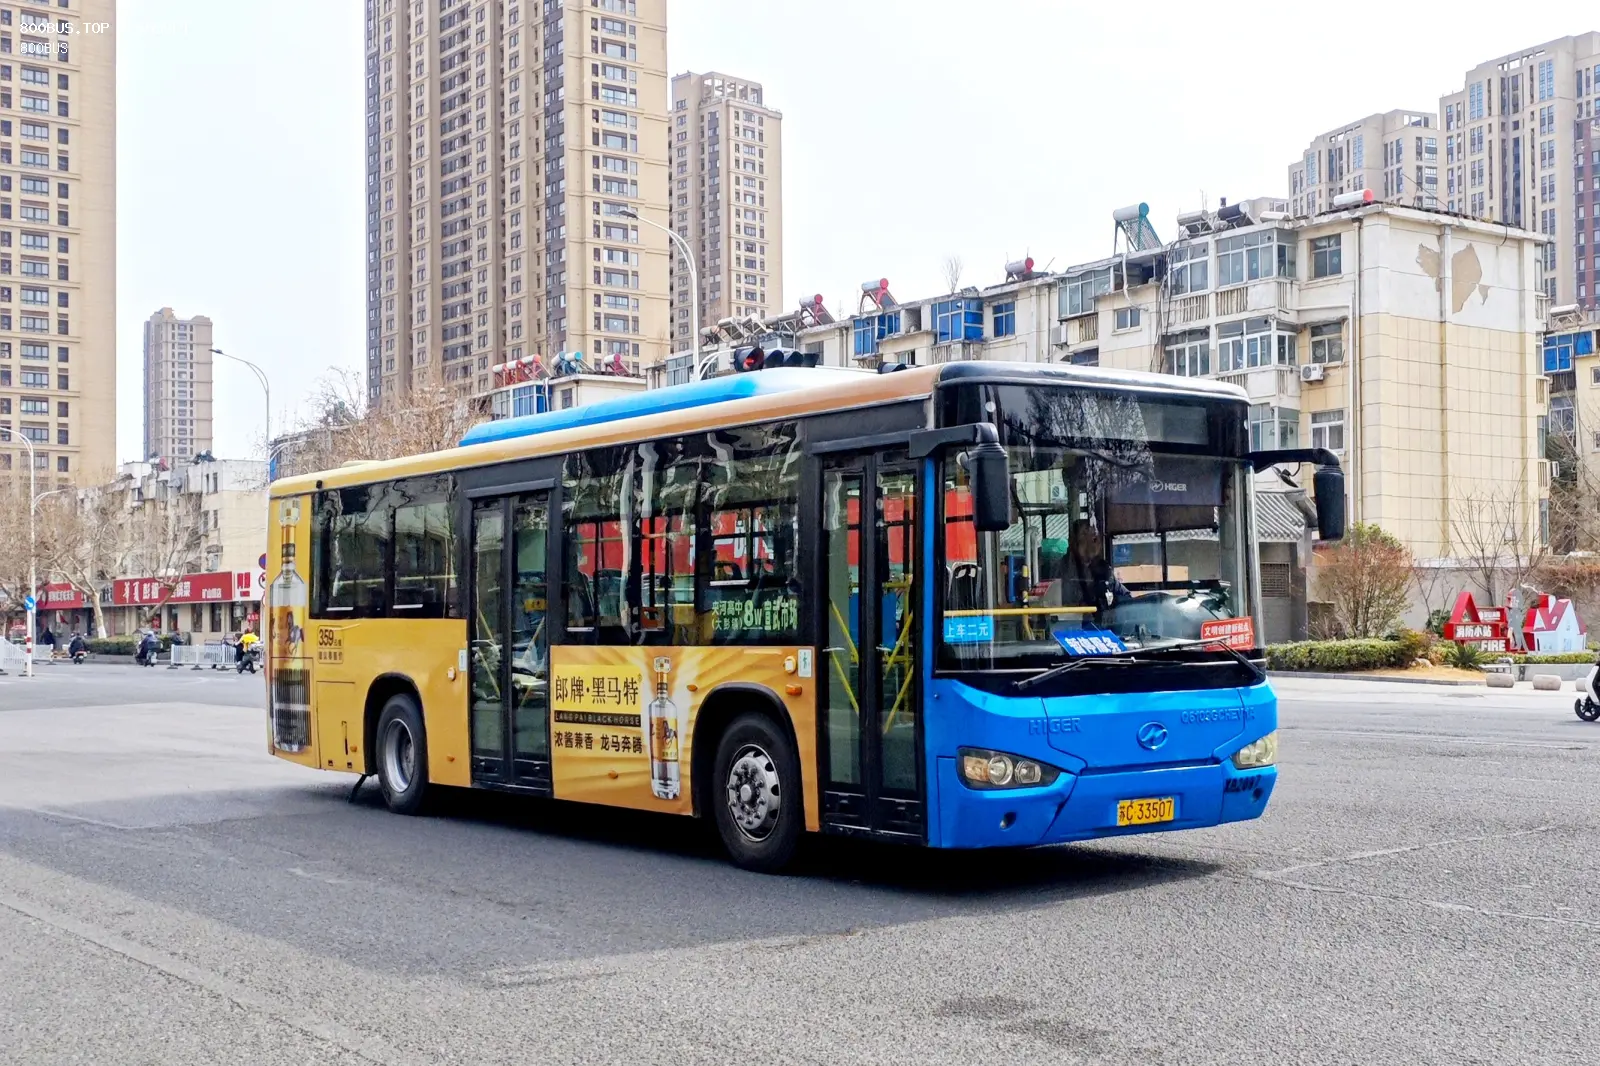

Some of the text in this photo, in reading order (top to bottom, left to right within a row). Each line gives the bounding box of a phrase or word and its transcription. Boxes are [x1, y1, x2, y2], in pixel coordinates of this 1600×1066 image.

[1164, 482, 1187, 492] HIGER
[318, 628, 335, 646] 359
[945, 623, 989, 638] 上车二元
[1455, 624, 1493, 638] 消防小站
[1481, 640, 1506, 652] FIRE
[1029, 717, 1081, 735] HIGER
[554, 731, 643, 754] 浓酱兼香 龙马奔腾
